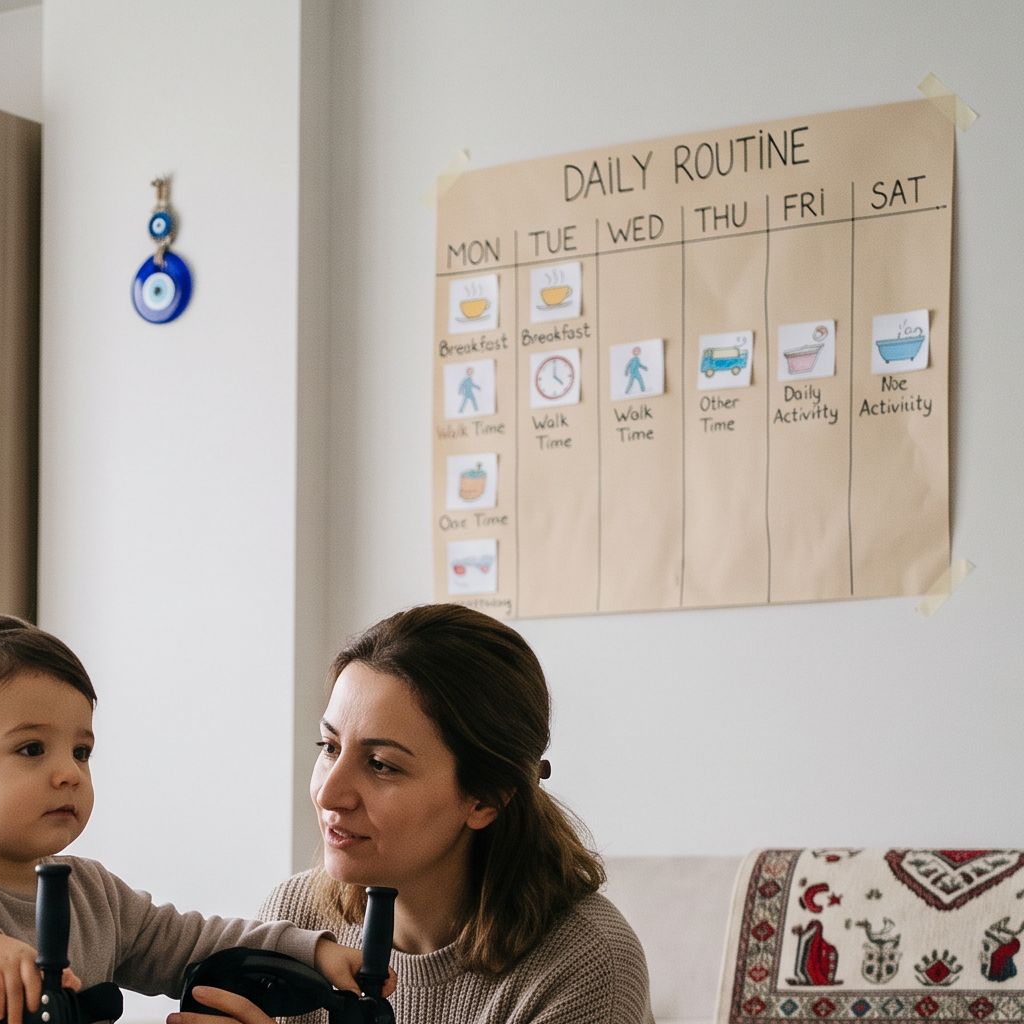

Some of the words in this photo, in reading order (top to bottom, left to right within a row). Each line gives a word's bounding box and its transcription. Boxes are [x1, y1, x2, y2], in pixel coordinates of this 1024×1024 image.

[871, 175, 926, 209] SAT
[694, 201, 748, 232] THU
[607, 214, 665, 244] WED
[528, 225, 577, 256] TUE
[446, 236, 501, 268] MON
[521, 322, 591, 346] Breakfast
[439, 334, 509, 357] Breakfast
[700, 395, 740, 412] Other
[784, 384, 822, 404] Daily
[532, 413, 569, 430] Walk
[614, 404, 653, 422] Walk
[616, 427, 654, 442] Time
[700, 417, 736, 432] Time
[536, 435, 573, 450] Time
